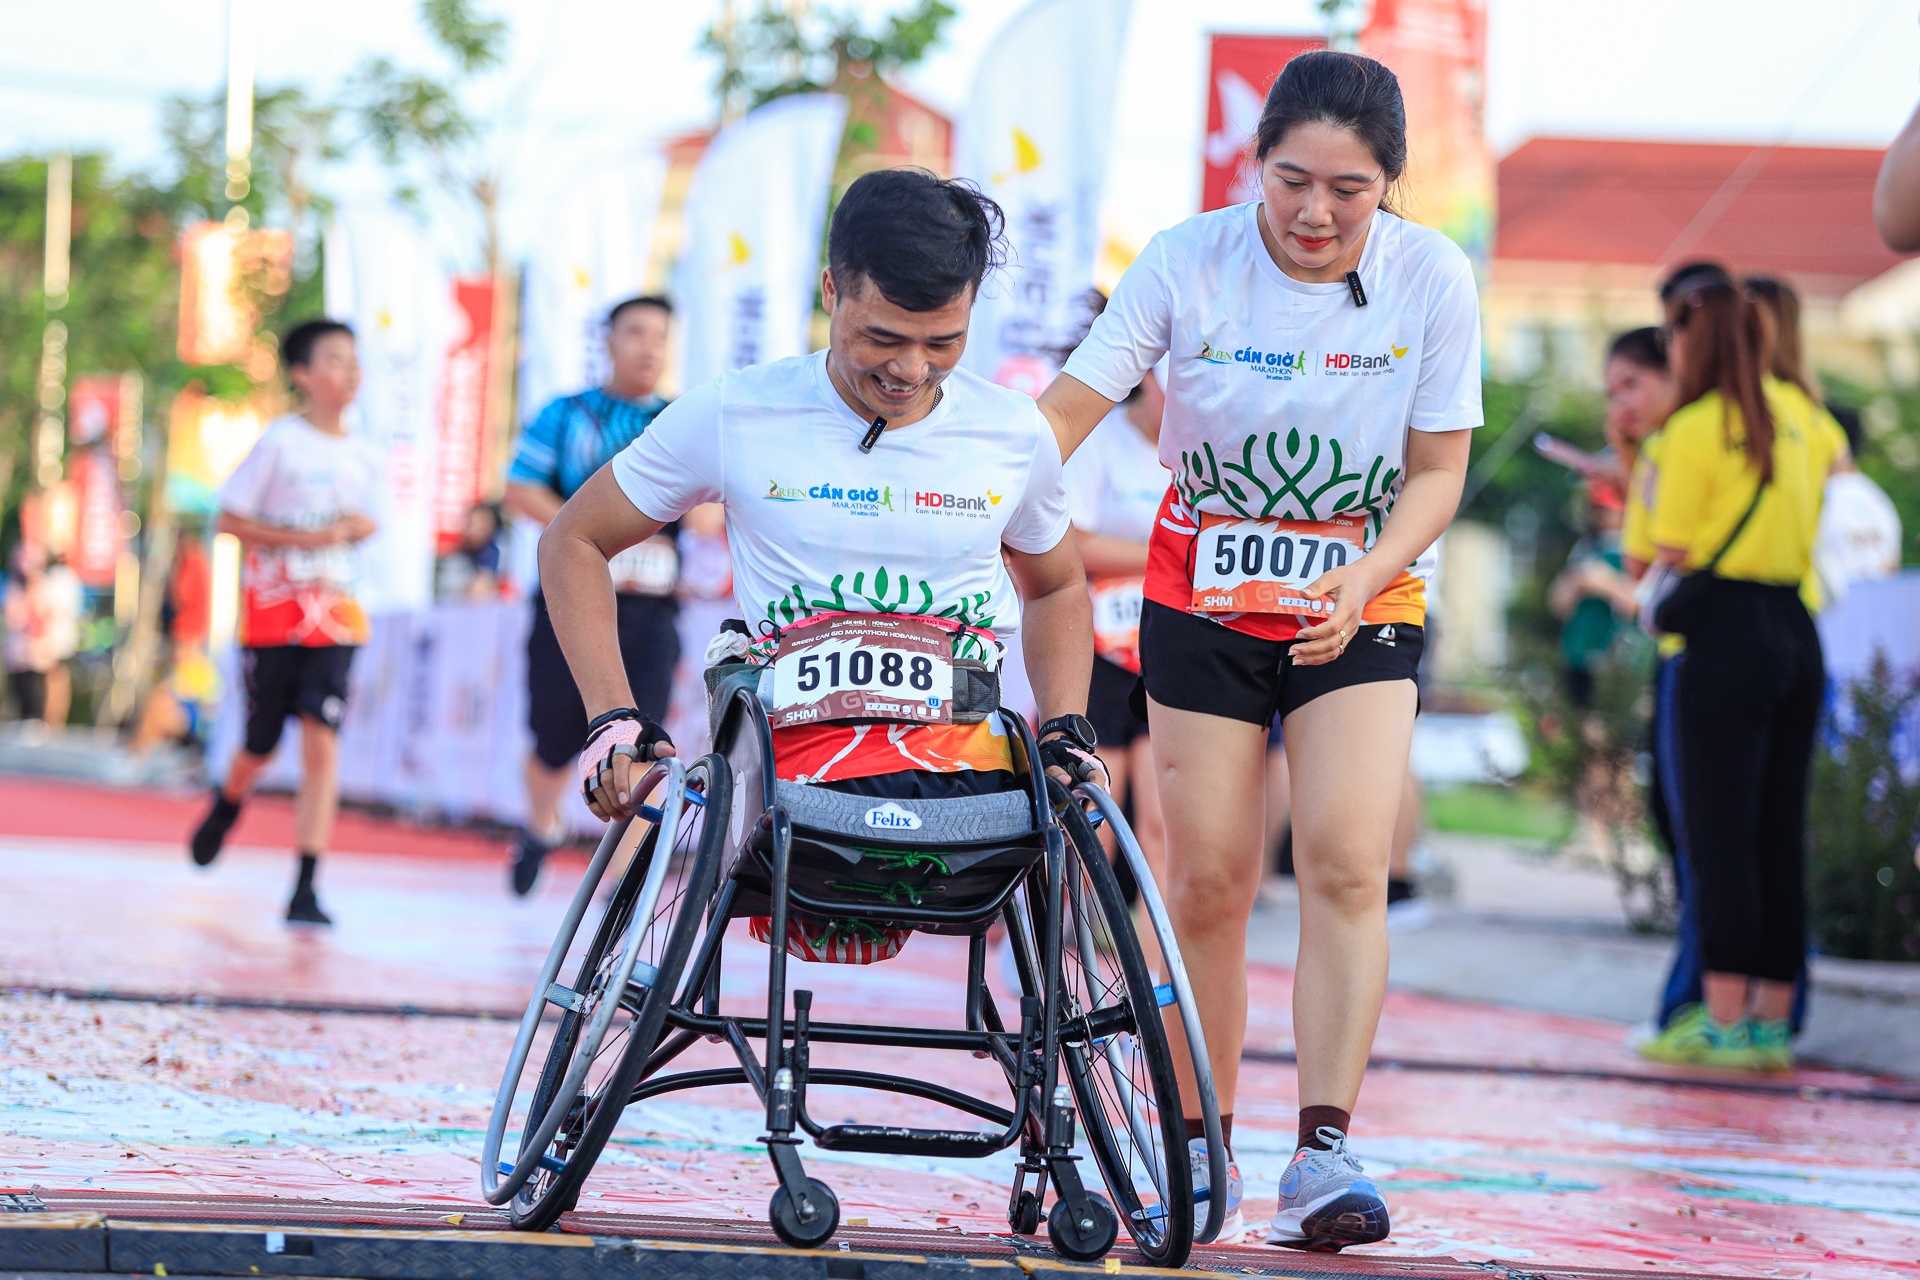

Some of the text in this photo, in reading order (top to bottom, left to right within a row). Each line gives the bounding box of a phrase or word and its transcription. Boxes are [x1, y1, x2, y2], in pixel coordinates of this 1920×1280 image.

[1234, 346, 1262, 364] CẦN
[1265, 352, 1295, 367] GIỜ
[1325, 353, 1391, 369] HDBank
[1250, 365, 1293, 375] MARATHON
[808, 483, 843, 500] CẦN
[847, 487, 879, 503] GIỜ
[915, 491, 987, 511] HDBank
[831, 501, 879, 511] MARATHON
[1335, 518, 1354, 527] 2024
[1214, 534, 1347, 579] 50070
[791, 637, 815, 647] GREEN
[815, 632, 830, 641] CAN
[844, 629, 889, 638] MARATHON
[889, 631, 921, 642] HDBANK
[921, 637, 940, 646] 2024
[797, 650, 934, 692] 51088
[871, 811, 912, 827] Felix
